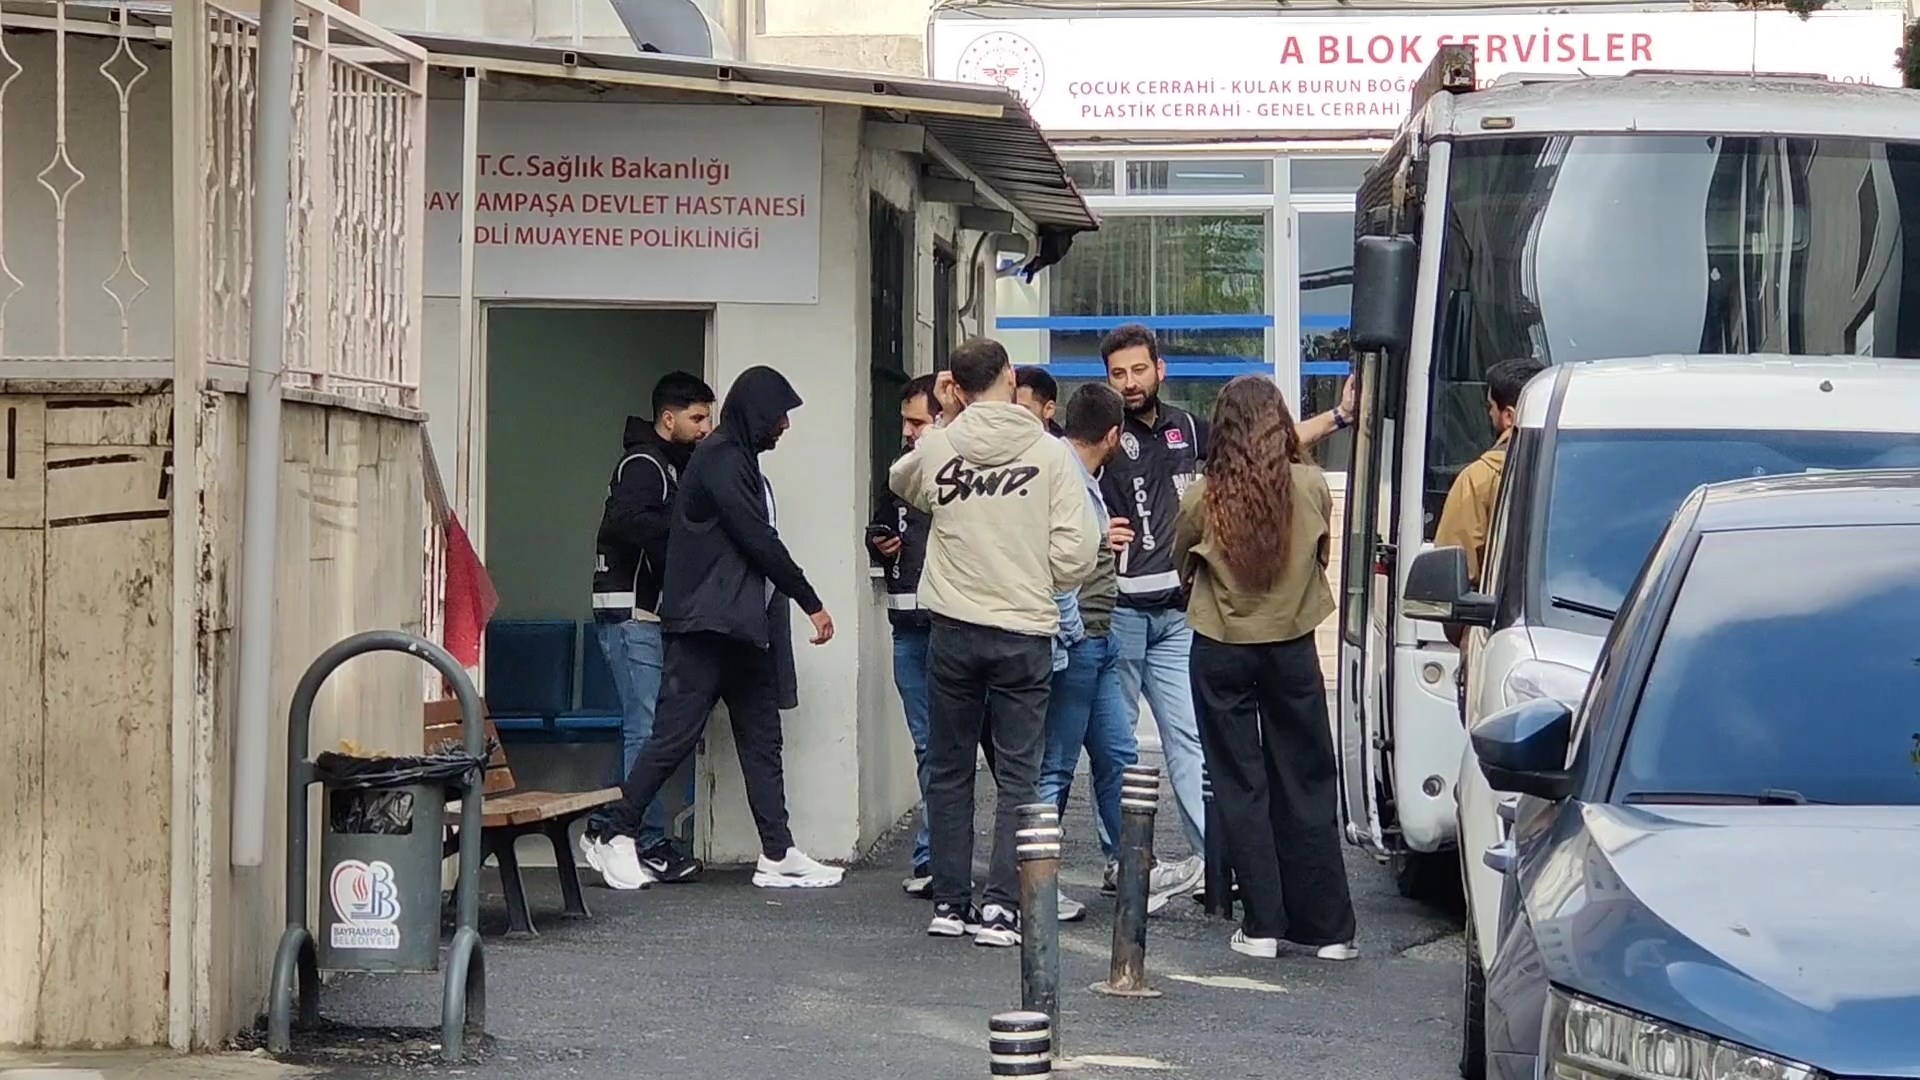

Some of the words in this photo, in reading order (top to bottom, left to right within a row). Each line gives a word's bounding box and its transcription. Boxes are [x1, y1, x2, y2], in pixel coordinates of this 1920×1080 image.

[1280, 36, 1304, 64] A
[1319, 35, 1422, 64] BLOK
[1068, 81, 1131, 99] ÇOCUK
[1136, 77, 1215, 94] CERRAHİ
[1231, 80, 1292, 94] KULAK
[1298, 79, 1361, 93] BURUN
[1081, 101, 1155, 118] PLASTİK
[1161, 101, 1240, 117] CERRAHİ
[1257, 102, 1315, 116] GENEL
[1321, 99, 1400, 116] CERRAHİ
[611, 156, 730, 186] Bakanlığı
[424, 191, 575, 218] AYAMPAŞA
[581, 193, 669, 214] DEVLET
[675, 194, 805, 217] HASTANESİ
[458, 223, 508, 245] DLİ
[514, 226, 624, 247] MUAYENE
[630, 225, 759, 249] POLİKLİNİĞİ
[892, 506, 908, 580] POS
